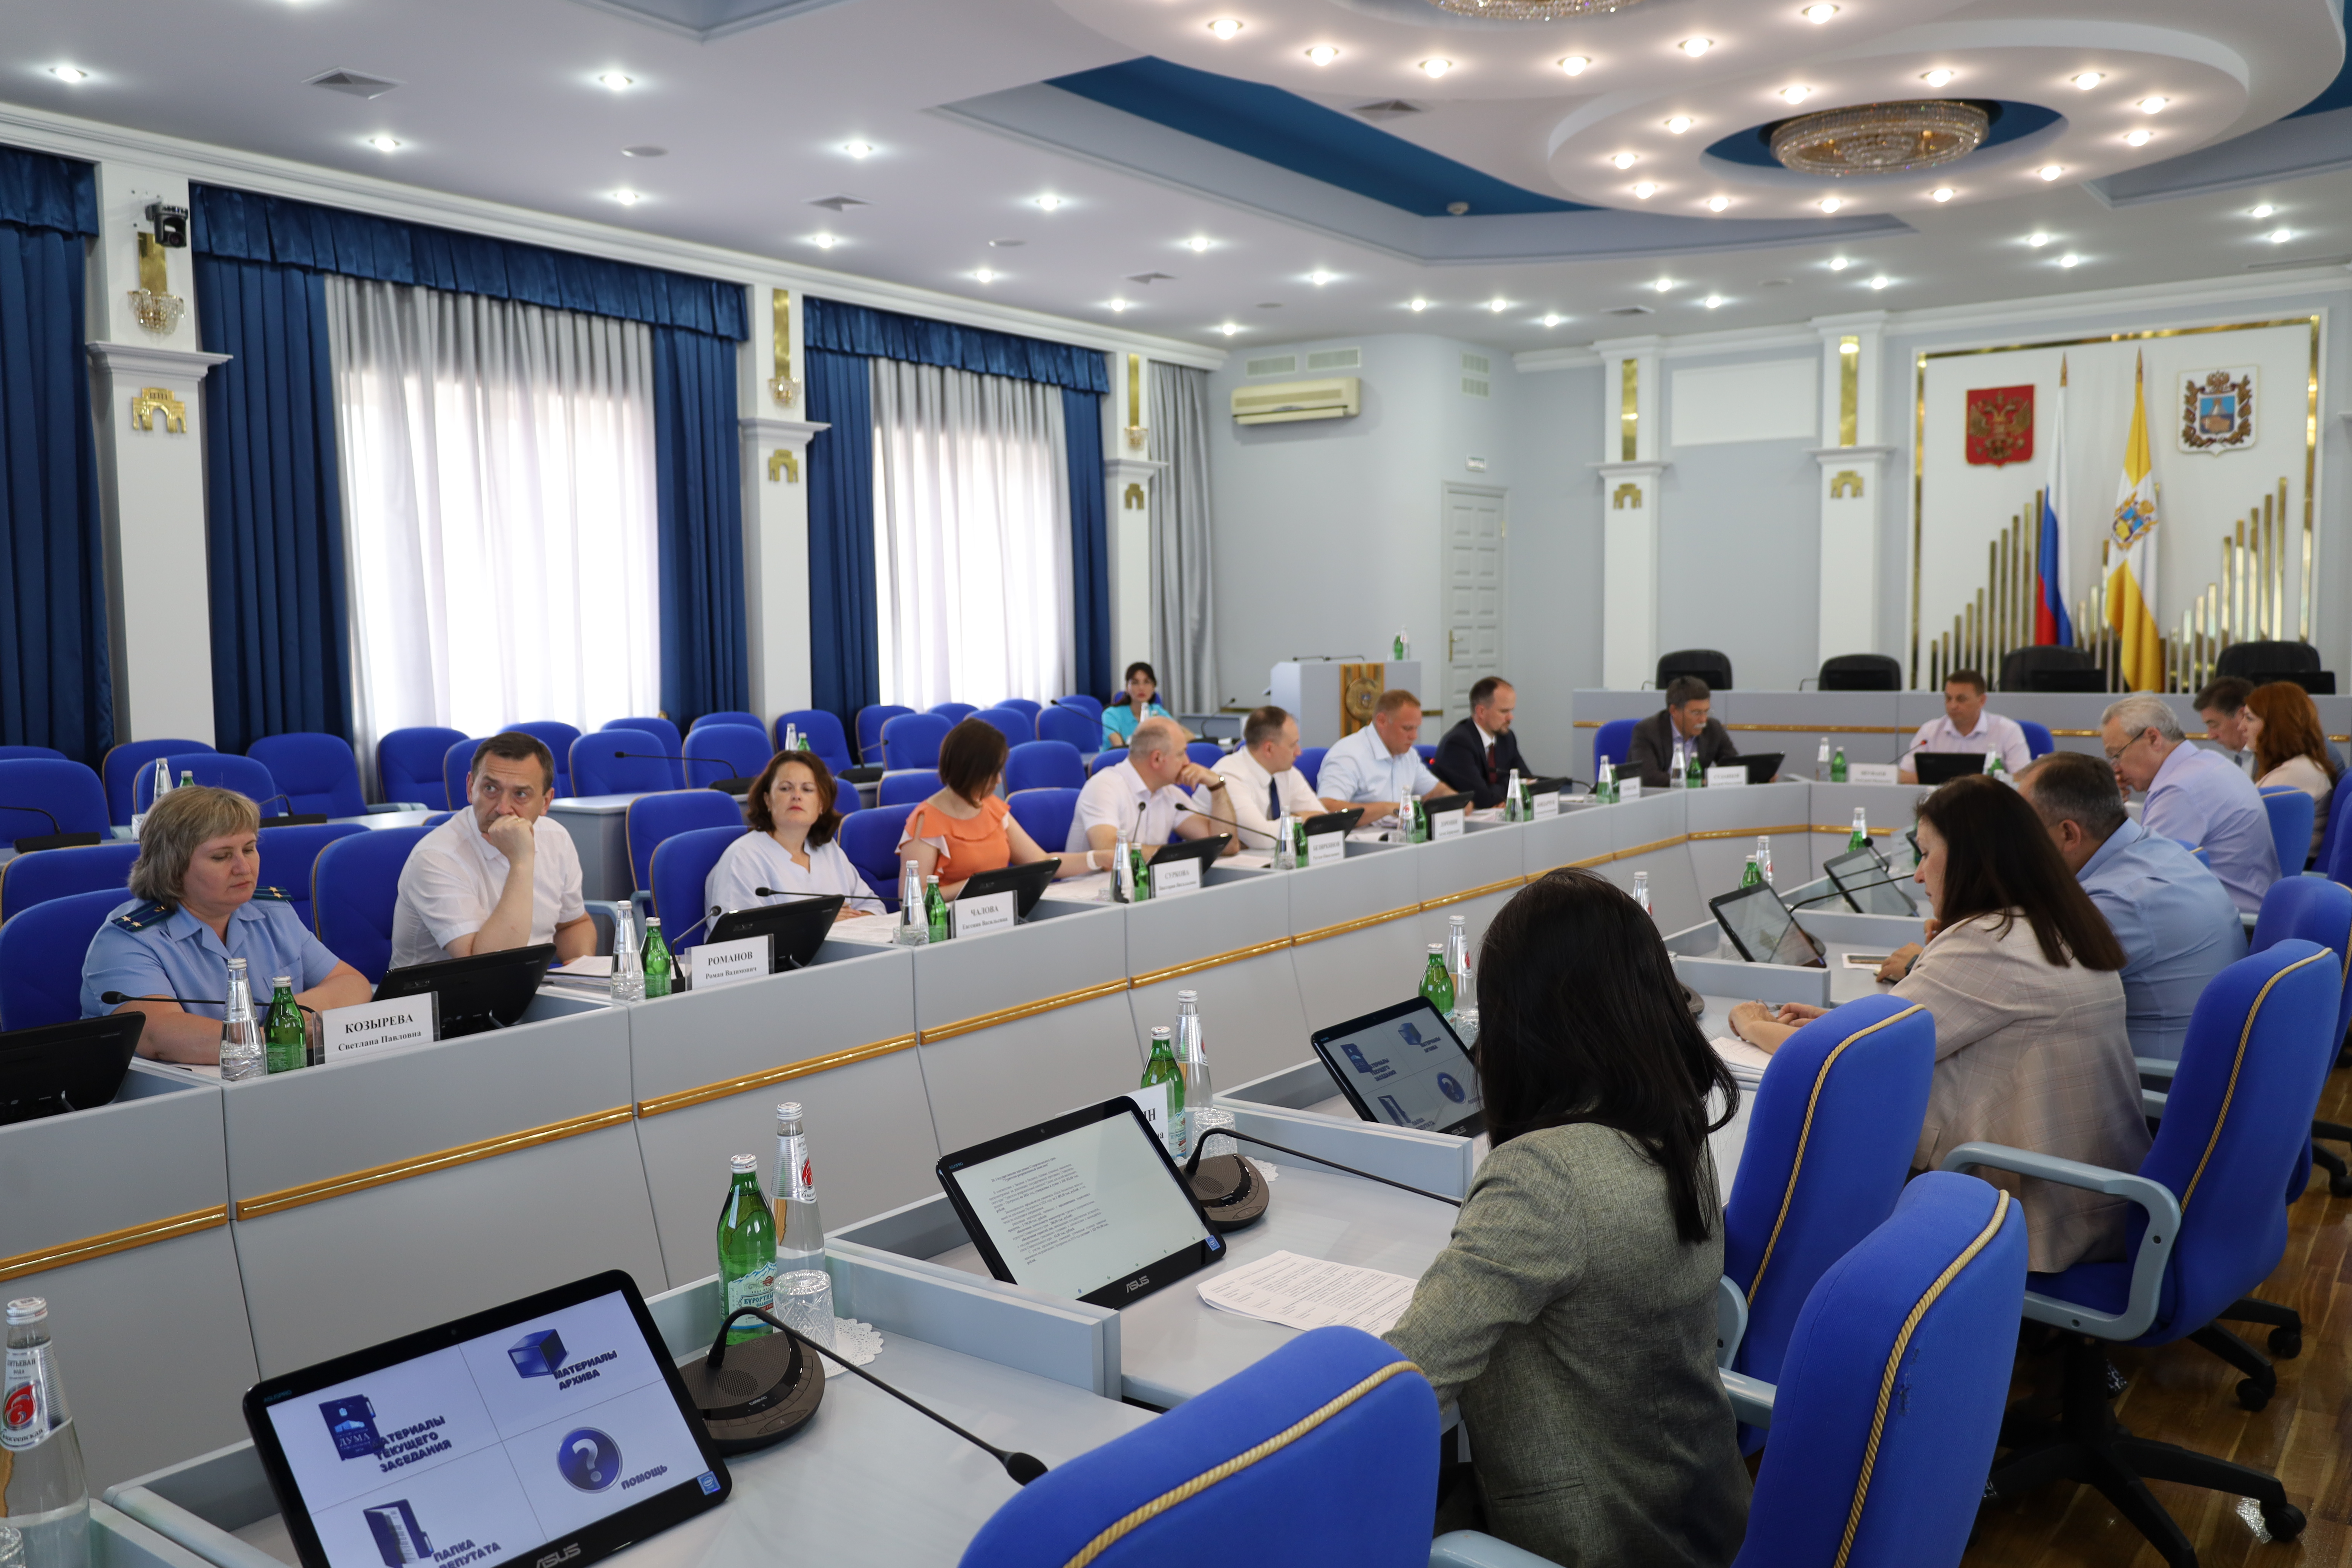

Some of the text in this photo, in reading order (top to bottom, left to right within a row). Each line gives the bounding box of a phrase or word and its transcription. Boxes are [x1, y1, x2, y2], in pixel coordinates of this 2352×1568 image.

[971, 905, 999, 916] ЧАЛОВА
[982, 917, 1008, 926] Васильевна
[708, 951, 753, 966] РОМАНОВ
[725, 967, 756, 976] Вадимович
[345, 1013, 413, 1034] КОЗЫРЕВА
[338, 1031, 421, 1051] Светлана Павловна
[1126, 1275, 1150, 1293] ASUS
[553, 1350, 617, 1380] МАТЕРИАЛЫ
[559, 1369, 600, 1391] АРХИВА
[340, 1433, 371, 1448] ДУМА
[377, 1415, 446, 1446] АТЕРИАЛЫ
[374, 1432, 438, 1461] ТЕКУЩЕГО
[380, 1439, 452, 1473] ЗАСЕДАНИЯ
[621, 1465, 668, 1490] ПОМОЩЬ
[433, 1539, 476, 1563] ПАПКА
[536, 1543, 581, 1568] ASUS
